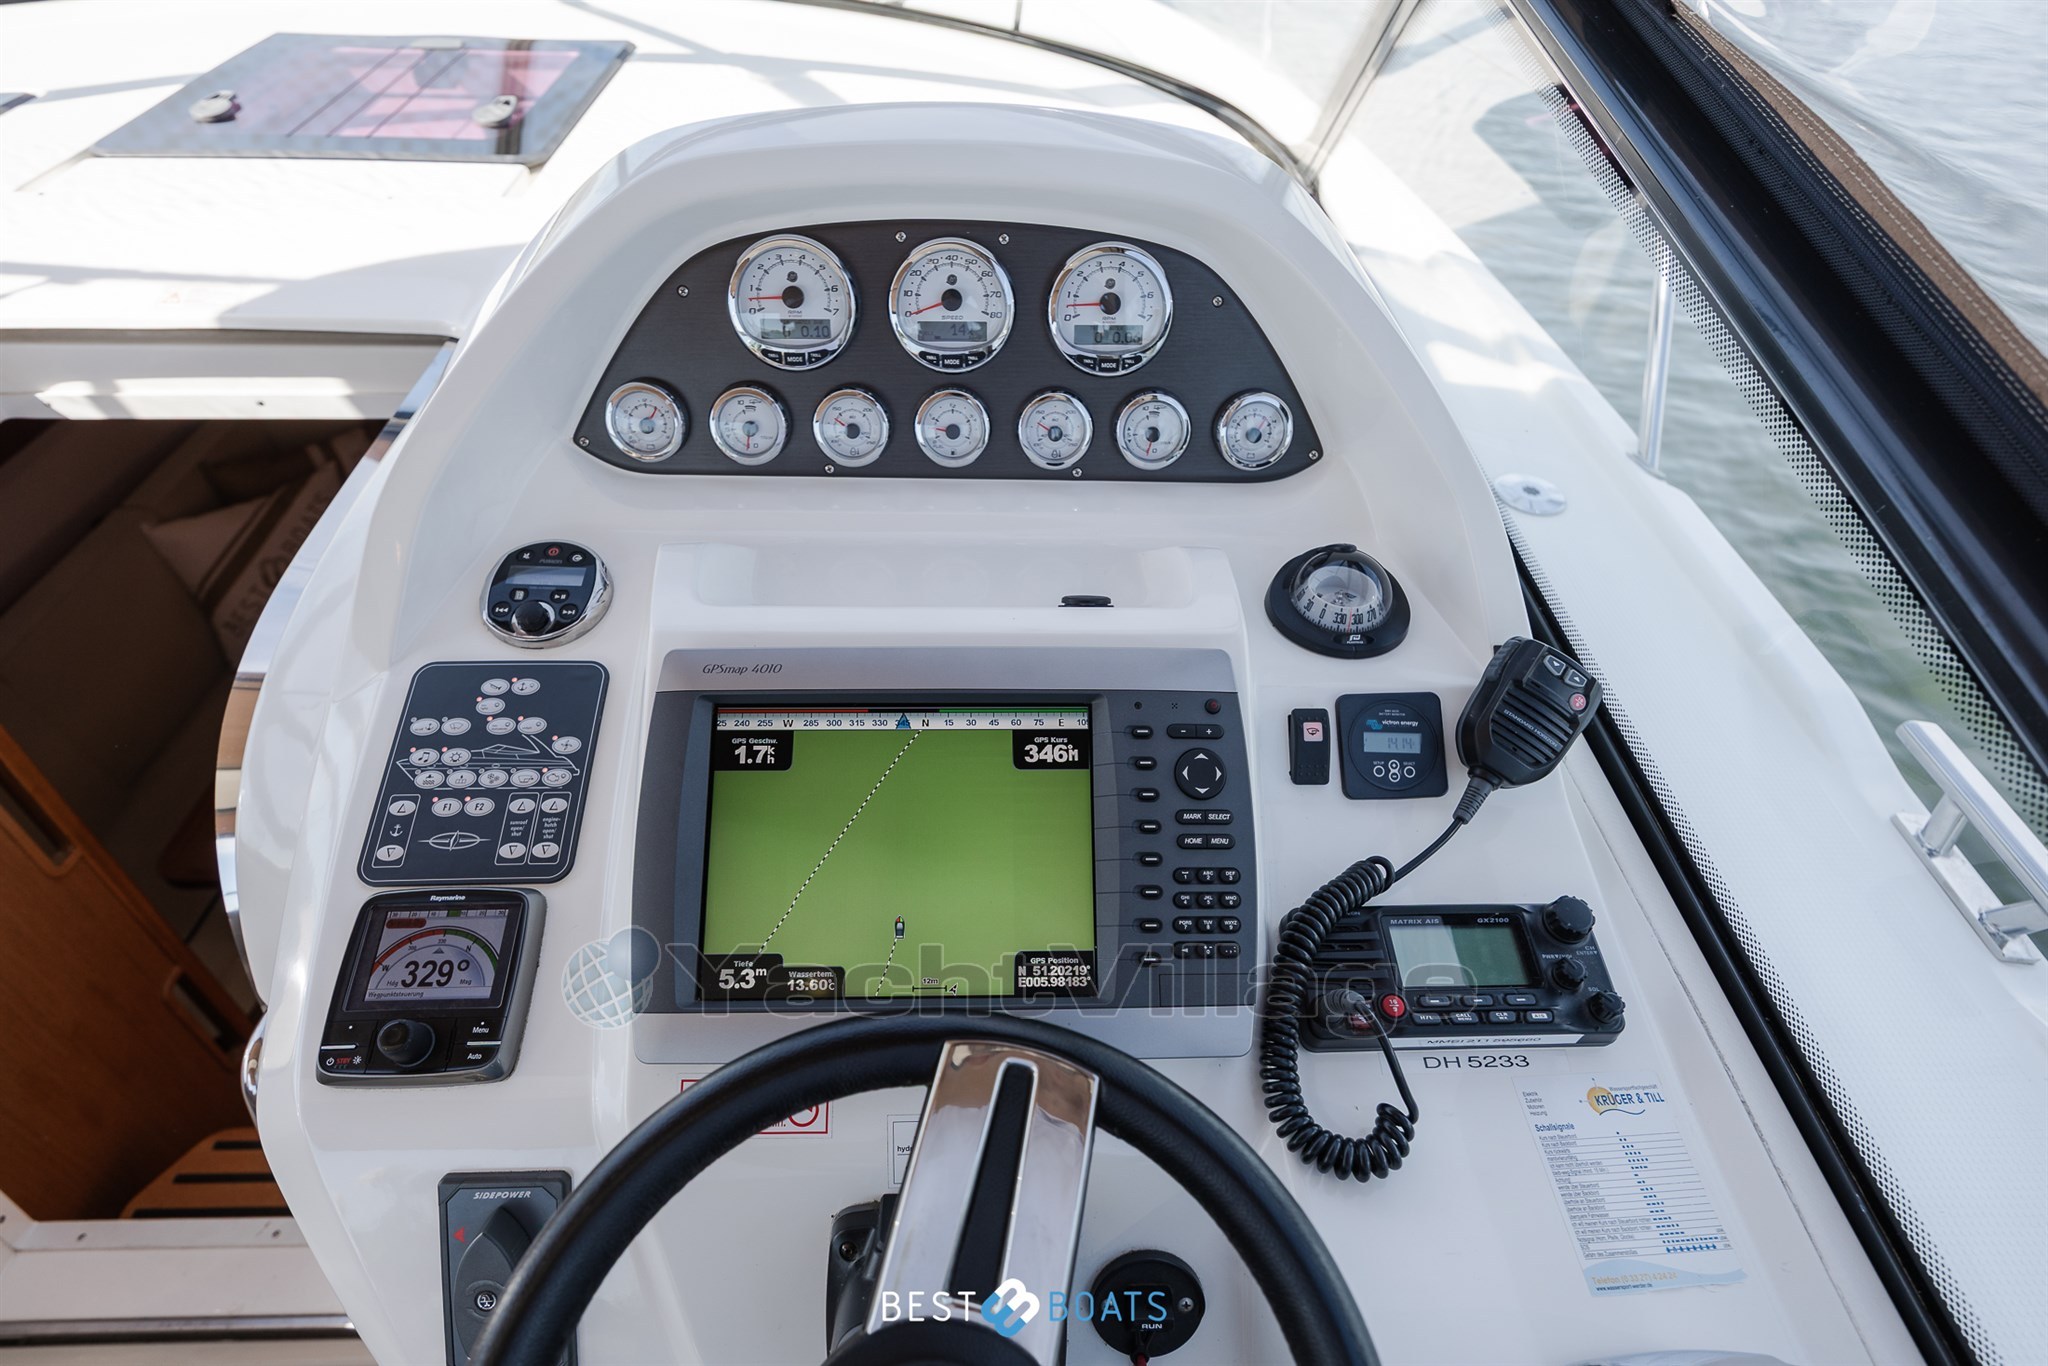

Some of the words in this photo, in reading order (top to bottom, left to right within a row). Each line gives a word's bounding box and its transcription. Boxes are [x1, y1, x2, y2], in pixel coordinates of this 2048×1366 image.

[909, 269, 922, 277] 20
[981, 270, 993, 278] 60
[749, 284, 754, 292] 1
[831, 285, 839, 293] 6
[831, 308, 840, 316] 7
[1064, 314, 1072, 322] 0
[1146, 314, 1153, 322] 7
[1304, 599, 1315, 612] 30
[1319, 609, 1327, 619] 0
[1333, 612, 1348, 625] 330
[1351, 613, 1364, 625] 300
[702, 663, 748, 676] GPSmap
[751, 663, 783, 675] 4010
[734, 719, 750, 728] 240
[757, 719, 773, 728] 255
[783, 719, 794, 728] W
[803, 719, 820, 728] 285
[826, 719, 842, 728] 300
[849, 719, 865, 728] 315
[872, 719, 888, 728] 330
[922, 719, 930, 728] N
[943, 719, 955, 728] 15
[966, 719, 977, 728] 30
[988, 719, 1000, 728] 45
[1010, 719, 1022, 728] 60
[1033, 719, 1045, 728] 75
[1058, 719, 1064, 728] E
[731, 737, 747, 745] GPS
[735, 745, 766, 765] 1.7
[442, 803, 452, 811] F1
[474, 803, 485, 811] F2
[430, 894, 466, 902] Raymarine
[1390, 918, 1423, 926] MATRIX
[1018, 965, 1026, 976] N
[718, 969, 756, 989] 5.3
[922, 977, 939, 985] 12m
[367, 991, 424, 999] Wegpunktsteuerung
[472, 1026, 489, 1034] Menu
[467, 1052, 483, 1060] Auto
[1423, 1056, 1462, 1069] DH
[1468, 1055, 1530, 1068] 5233
[1594, 1093, 1636, 1107] KRÜGER
[1637, 1094, 1645, 1104] &
[1644, 1092, 1665, 1103] TILL
[1535, 1122, 1575, 1133] Schallsignale
[473, 1190, 532, 1200] SIDEPOWER
